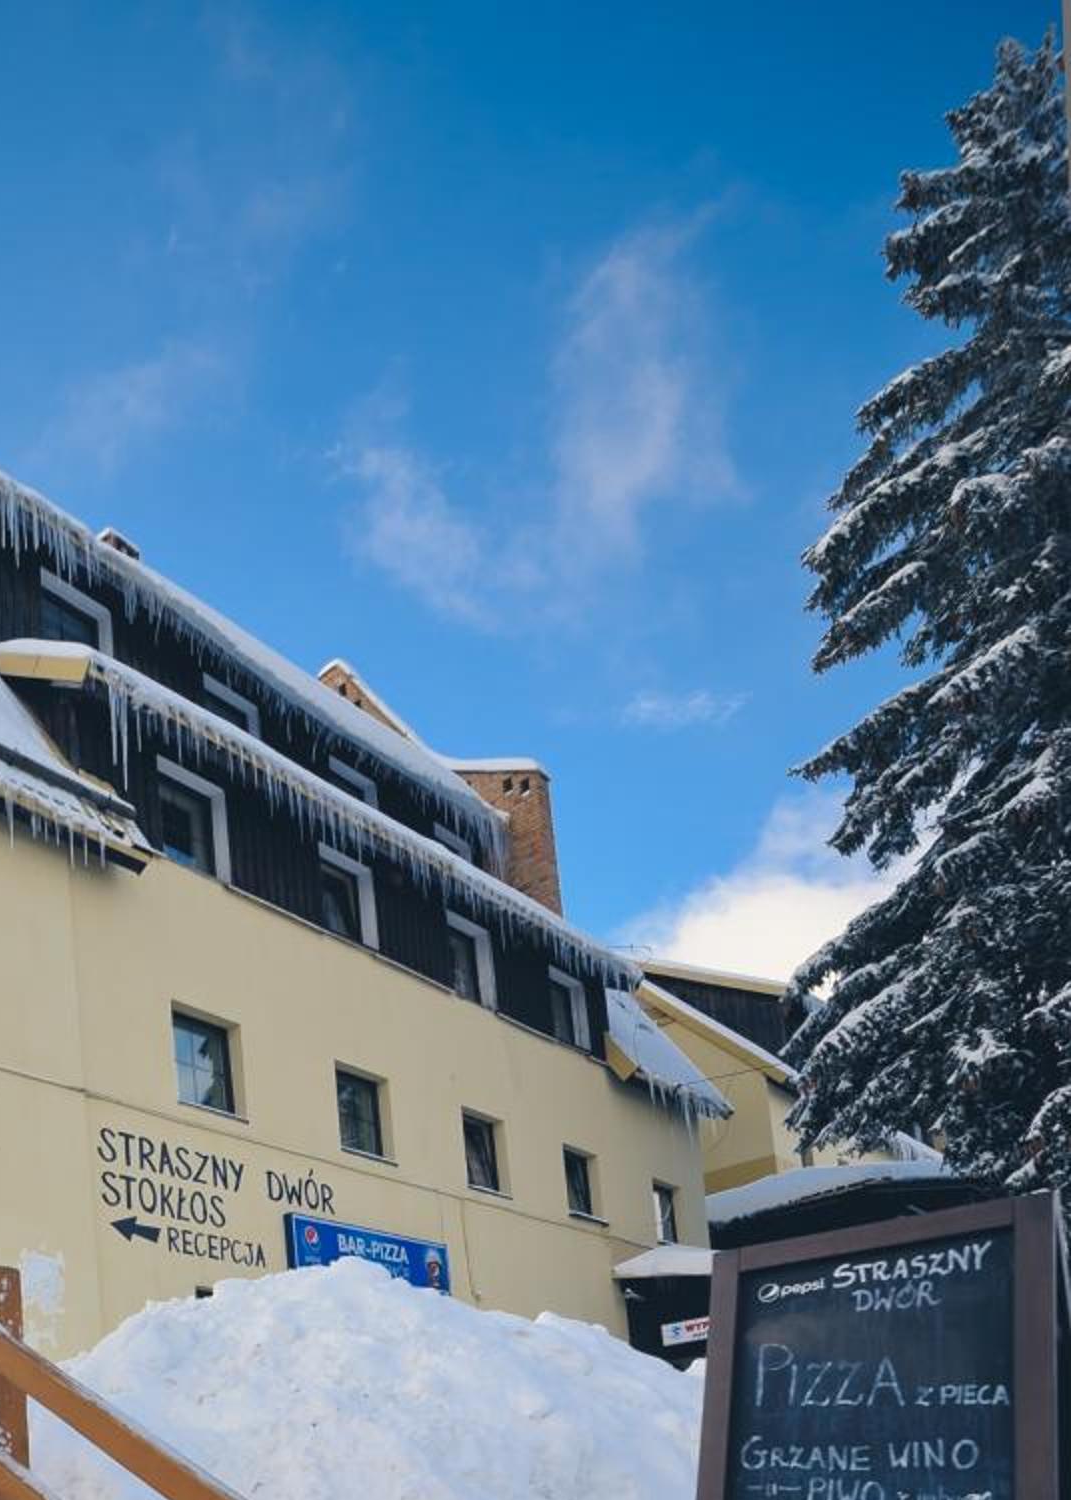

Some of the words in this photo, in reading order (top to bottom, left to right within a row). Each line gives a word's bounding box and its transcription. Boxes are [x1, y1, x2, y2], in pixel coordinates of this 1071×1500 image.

[96, 1127, 245, 1193] STRASZNY
[266, 1169, 336, 1216] DWÓR
[101, 1170, 227, 1228] STOKŁOS
[167, 1227, 267, 1269] RECEPCJA
[337, 1233, 410, 1265] BAR-PIZZA
[832, 1240, 993, 1290] STRASZNY
[780, 1277, 825, 1298] pepsi
[851, 1282, 942, 1313] DWÓR
[939, 1384, 1010, 1407] PIECA
[889, 1438, 979, 1471] WINO
